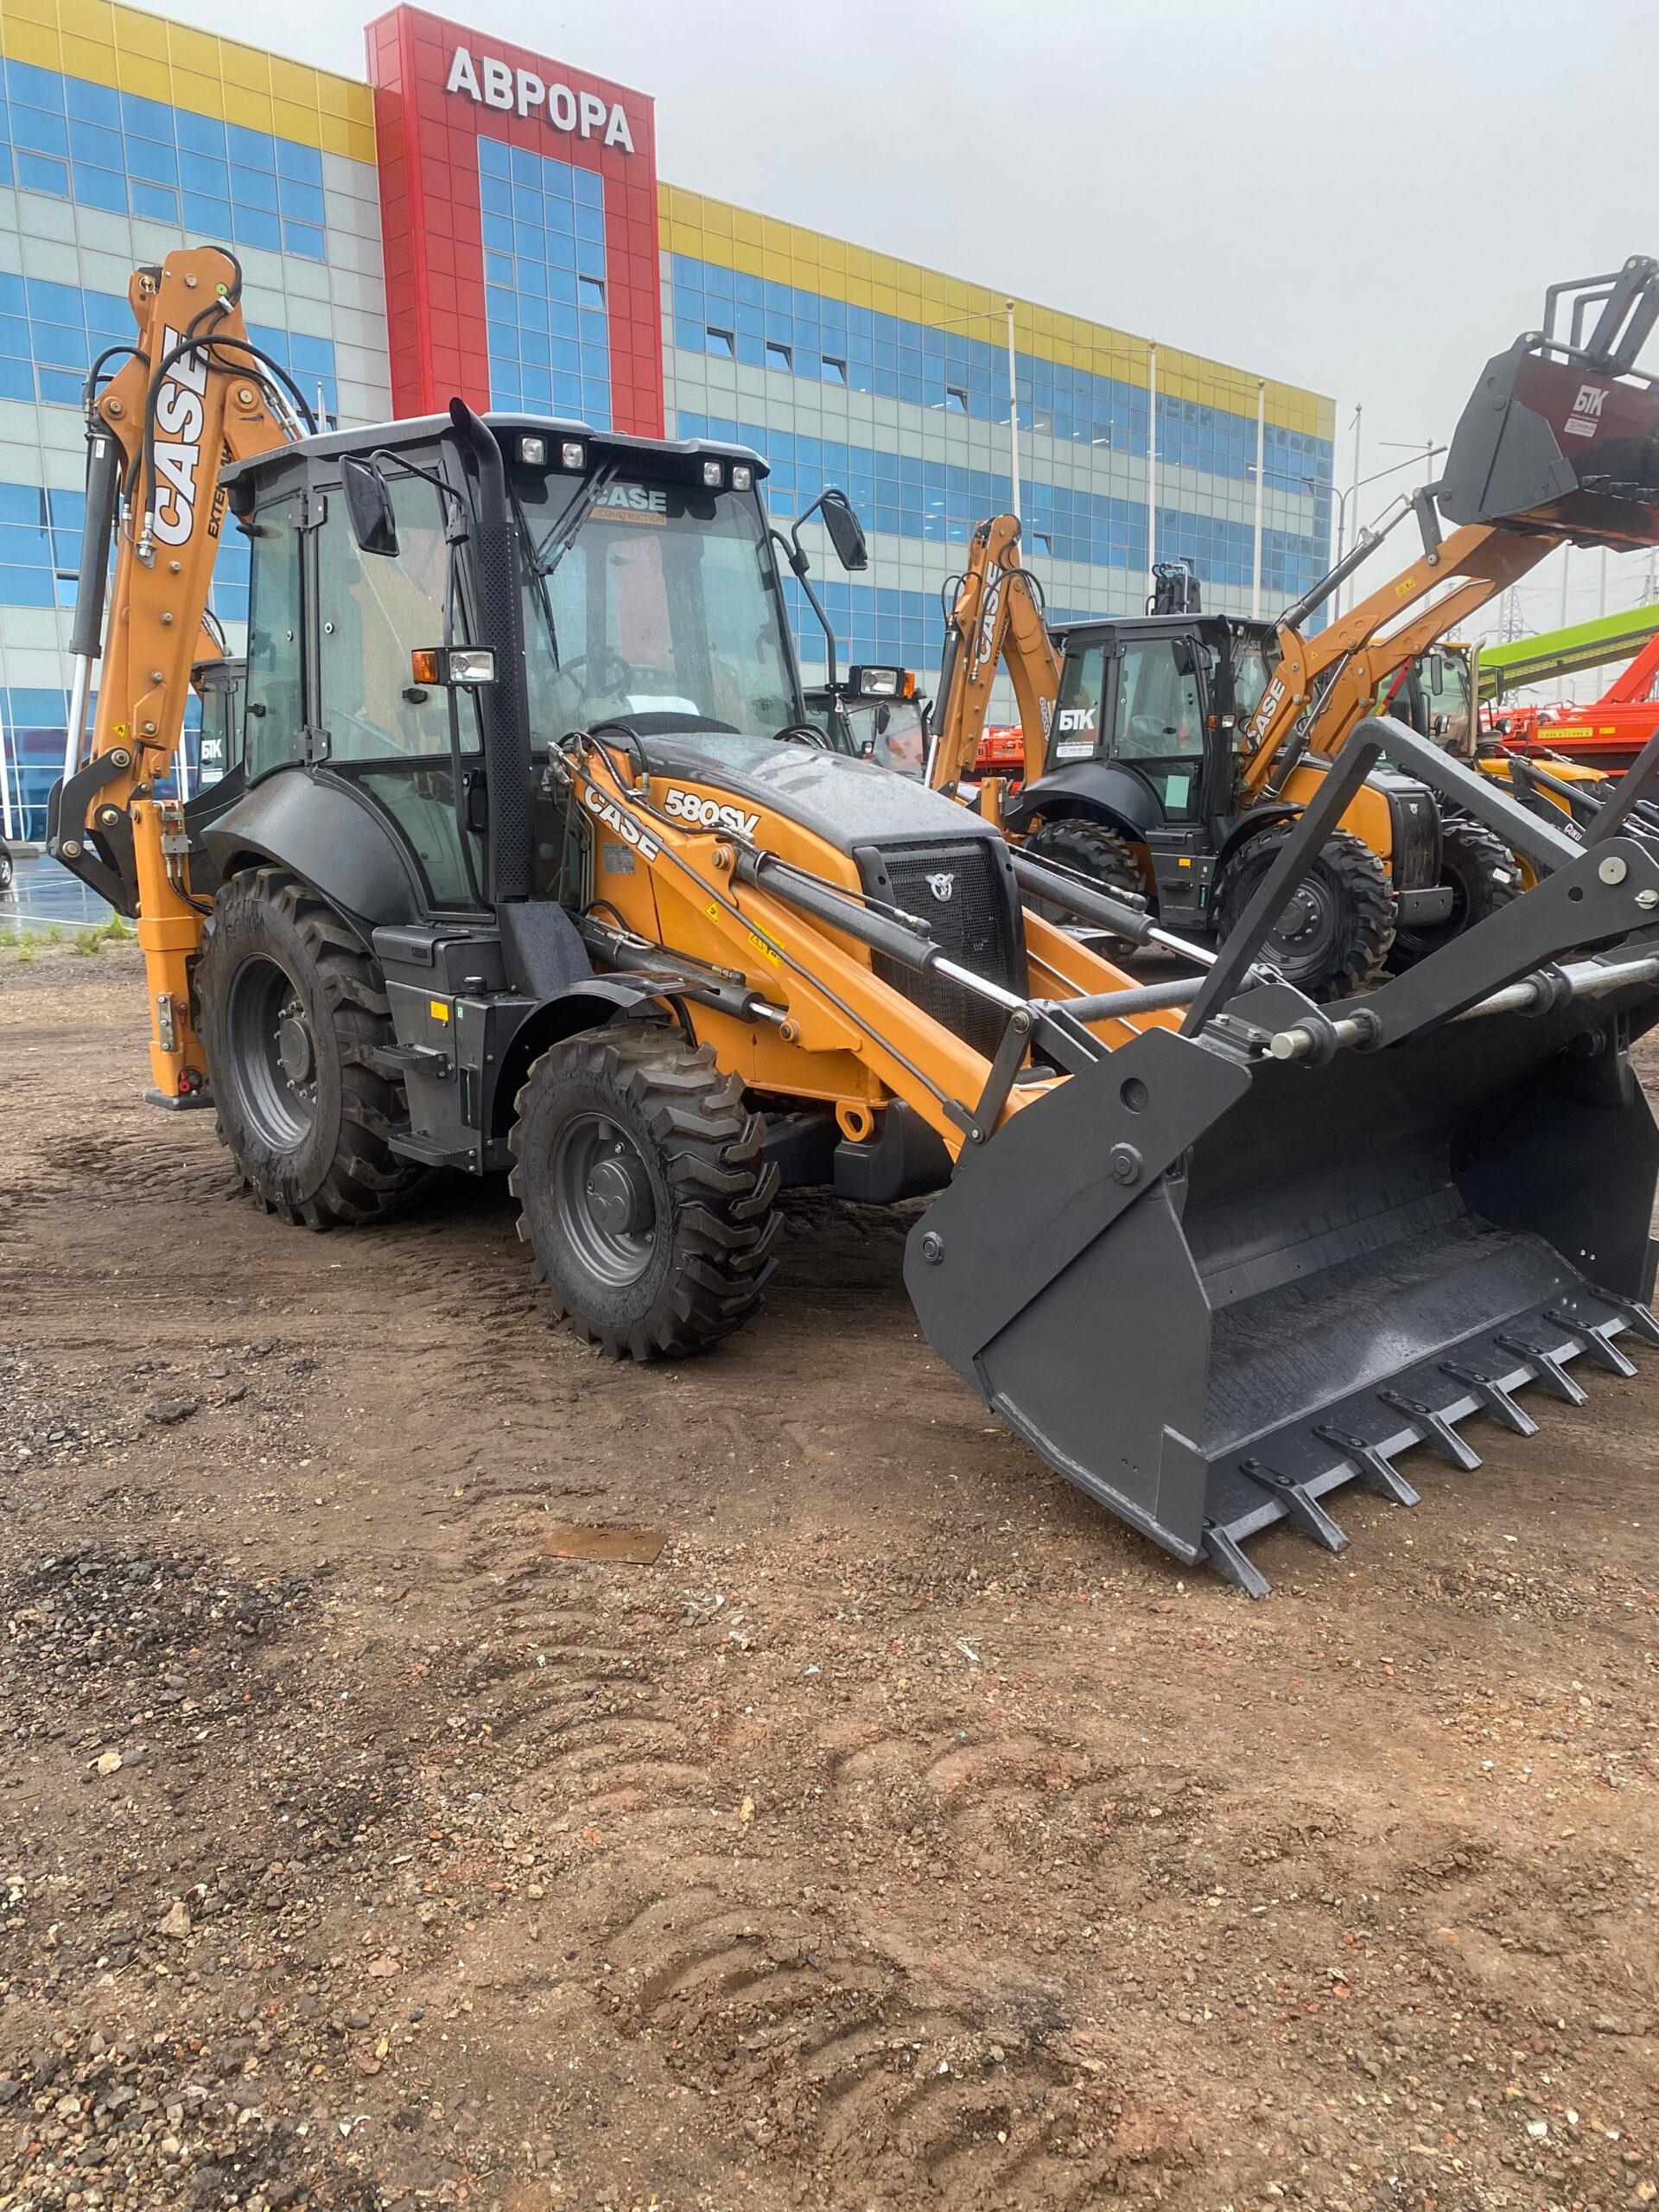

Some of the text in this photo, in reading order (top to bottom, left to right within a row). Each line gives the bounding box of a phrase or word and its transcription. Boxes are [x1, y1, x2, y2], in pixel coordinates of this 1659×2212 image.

[447, 46, 635, 154] АВРОРА
[1573, 385, 1610, 416] БТК
[152, 324, 210, 546] CASE
[598, 508, 665, 524] CONSTRUCTION
[975, 560, 1003, 664] CASE
[1059, 709, 1096, 731] БТК
[201, 739, 223, 760] БТК
[583, 783, 664, 862] CASE
[663, 787, 761, 835] 580SV
